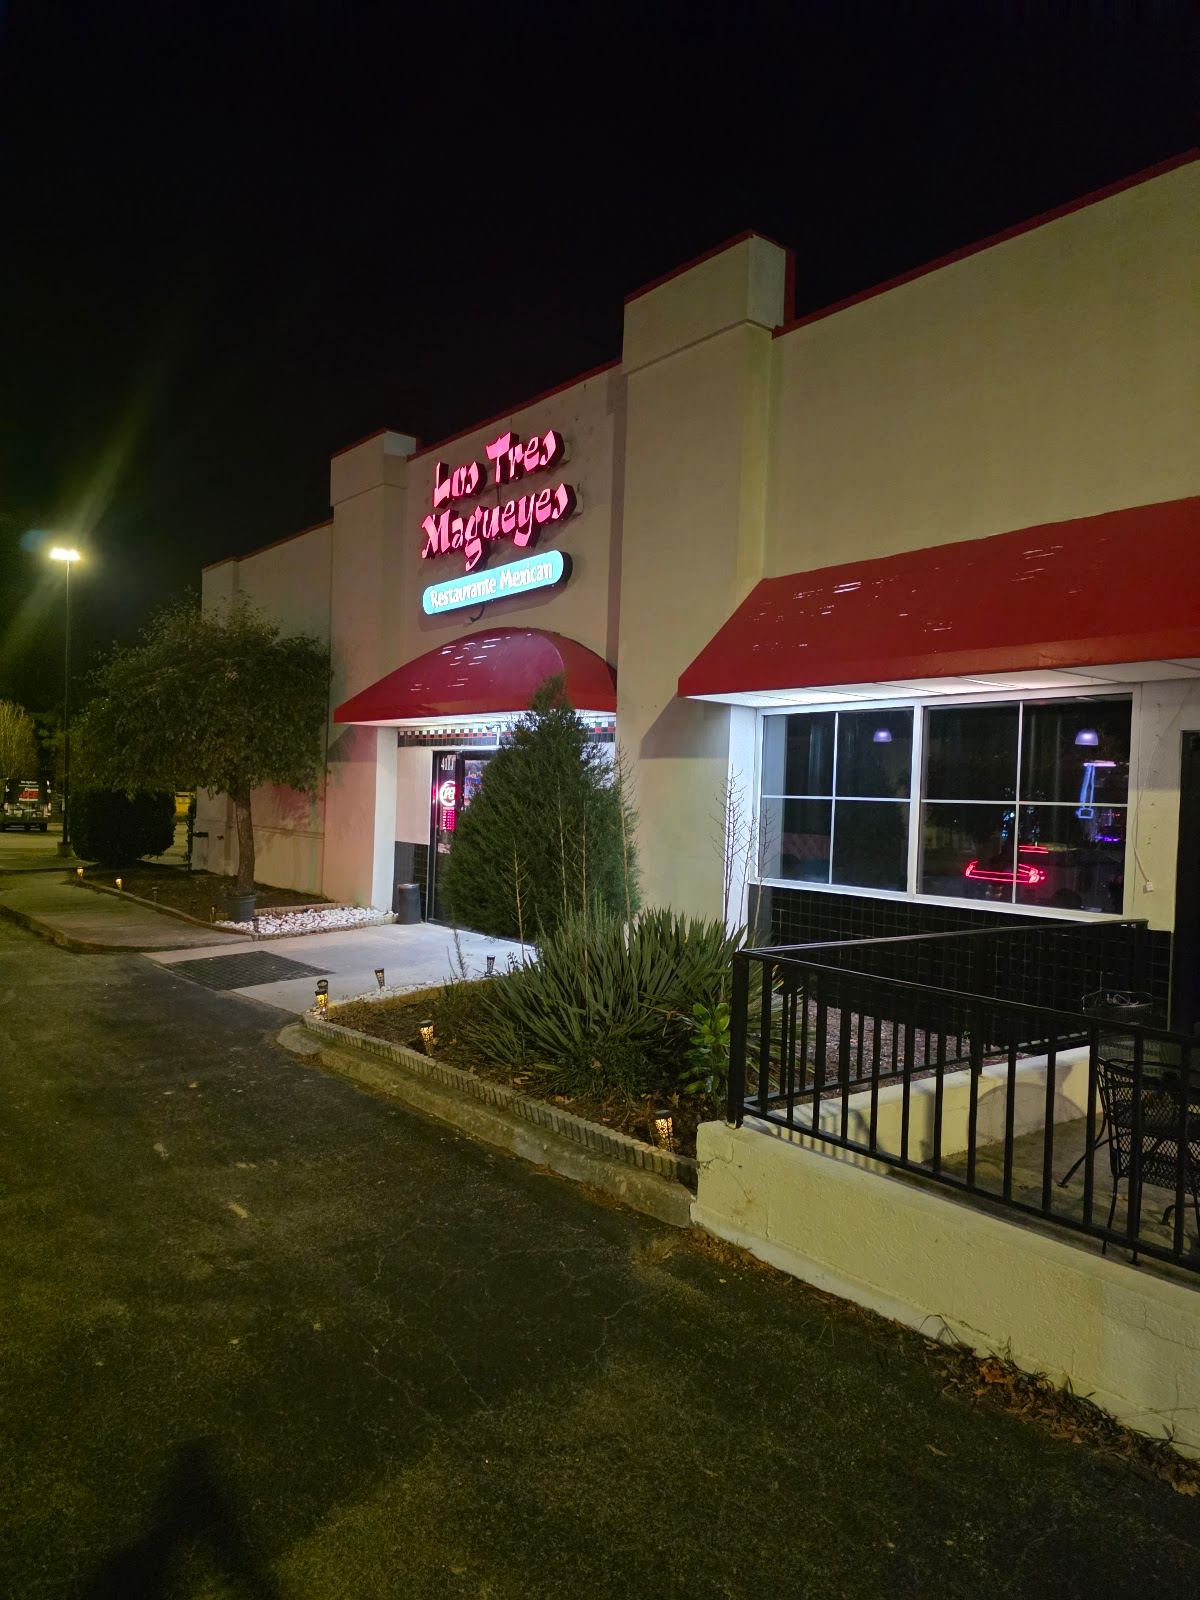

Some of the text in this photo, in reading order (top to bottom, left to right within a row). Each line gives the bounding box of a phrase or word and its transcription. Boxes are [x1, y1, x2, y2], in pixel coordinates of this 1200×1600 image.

[433, 430, 557, 508] Los Tres
[421, 483, 569, 572] Magueyes
[430, 561, 554, 609] Restaurante Mexican
